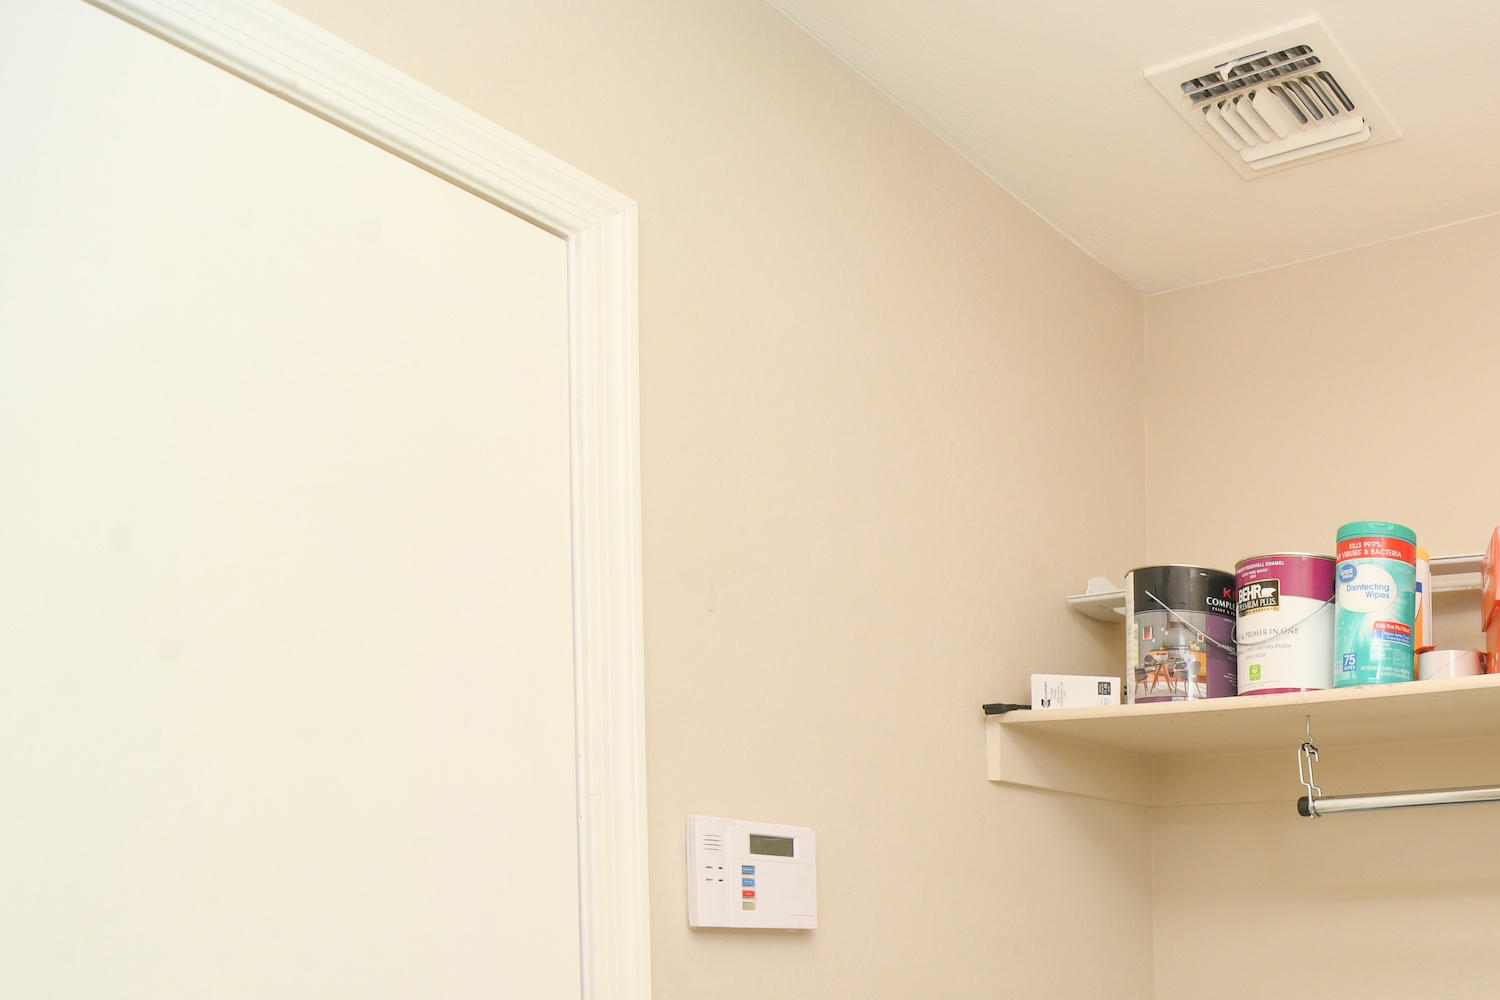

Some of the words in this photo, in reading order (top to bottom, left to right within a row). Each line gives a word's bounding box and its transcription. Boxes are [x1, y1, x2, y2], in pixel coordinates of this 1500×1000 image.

[1371, 549, 1402, 558] BACTERIA
[1346, 583, 1390, 593] Disinfecting
[1239, 584, 1262, 604] BEHR
[1365, 591, 1390, 600] Wipes
[1281, 627, 1300, 635] ONE
[1344, 654, 1356, 666] 75
